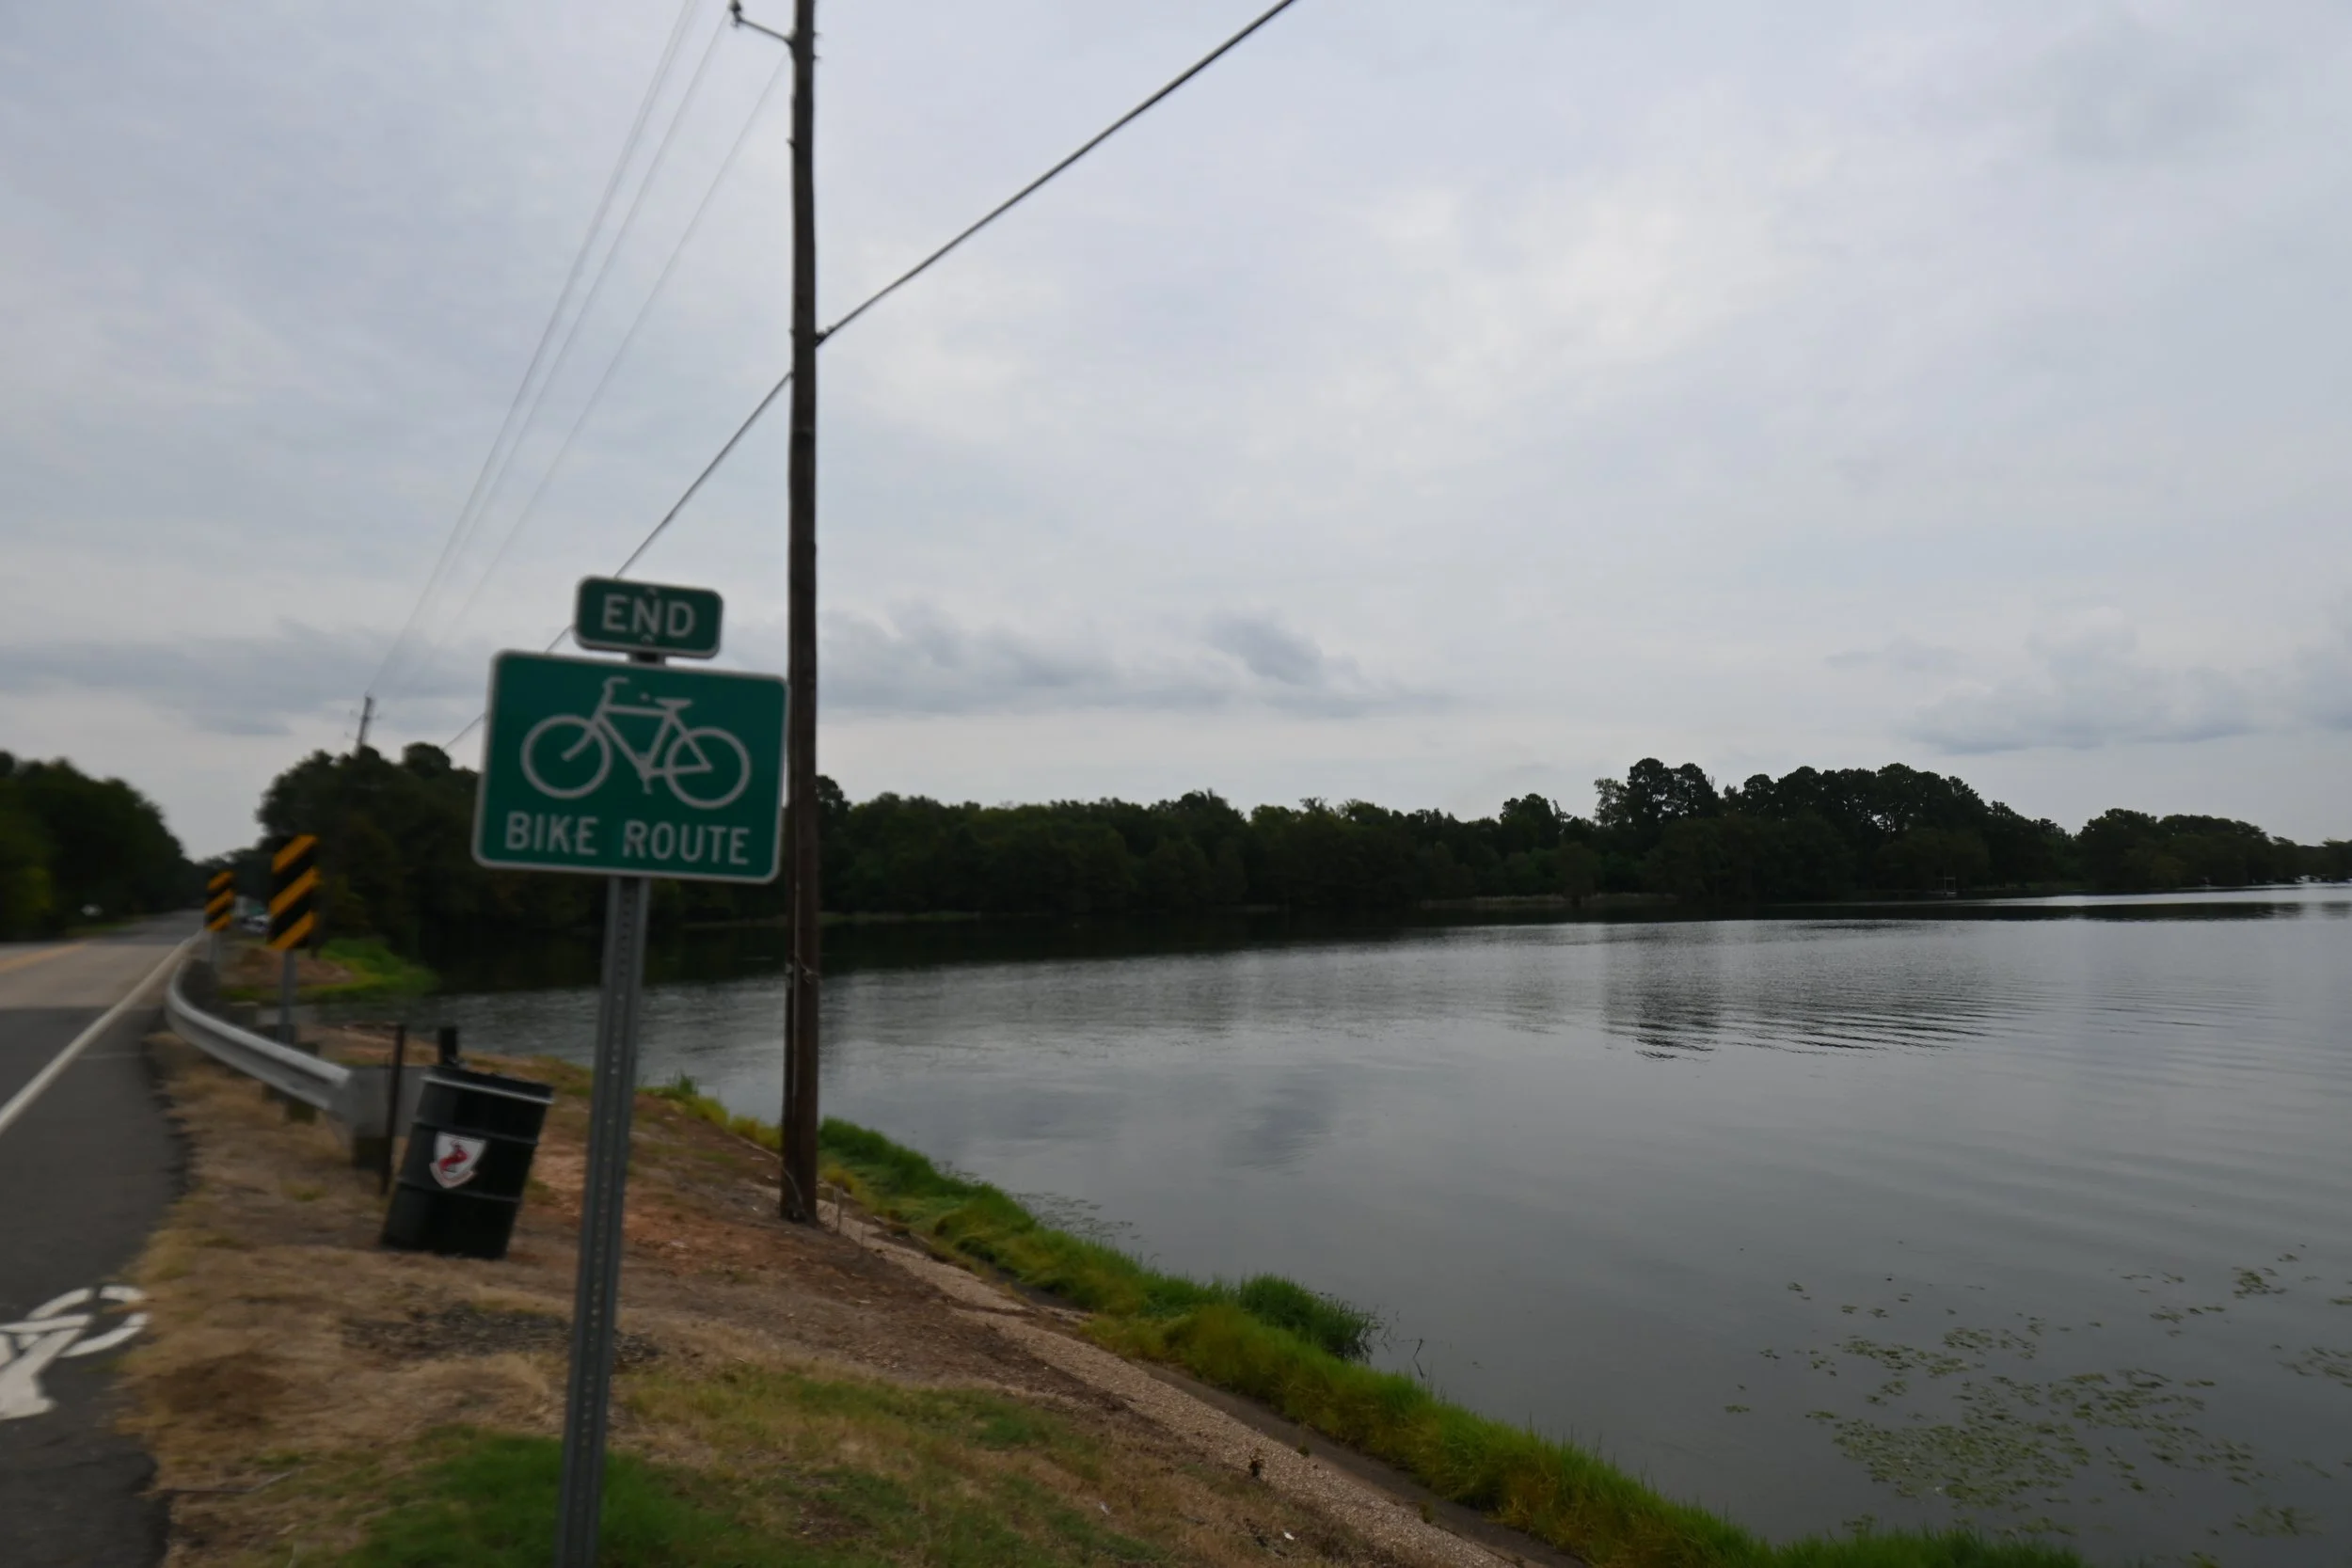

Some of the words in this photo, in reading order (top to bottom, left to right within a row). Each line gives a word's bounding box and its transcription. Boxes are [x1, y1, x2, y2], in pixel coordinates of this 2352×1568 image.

[601, 594, 695, 637] END
[505, 811, 598, 855] BIKE
[623, 820, 750, 864] ROUTE
